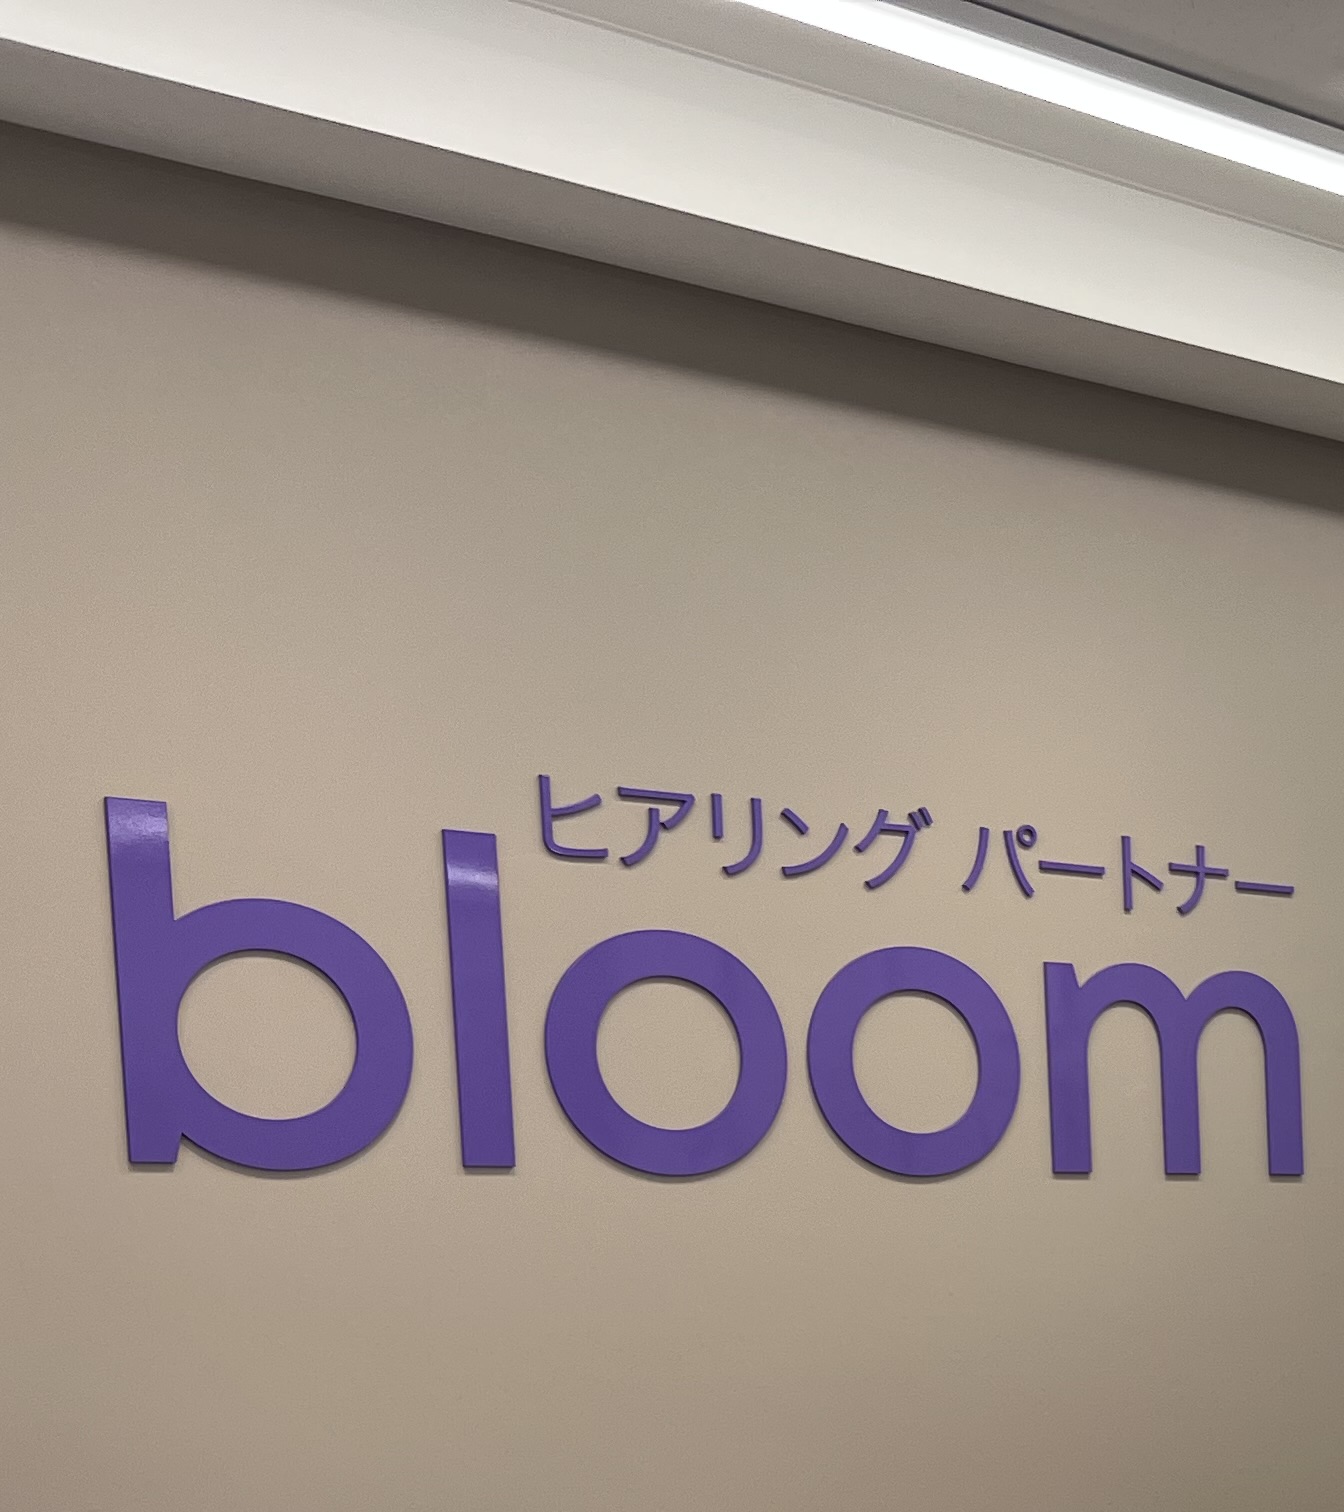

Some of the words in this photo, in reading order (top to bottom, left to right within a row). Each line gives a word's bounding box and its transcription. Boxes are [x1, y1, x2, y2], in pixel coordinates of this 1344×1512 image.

[536, 772, 933, 890] ヒアリング
[962, 821, 1296, 915] パートナー
[103, 794, 1305, 1178] bloom
